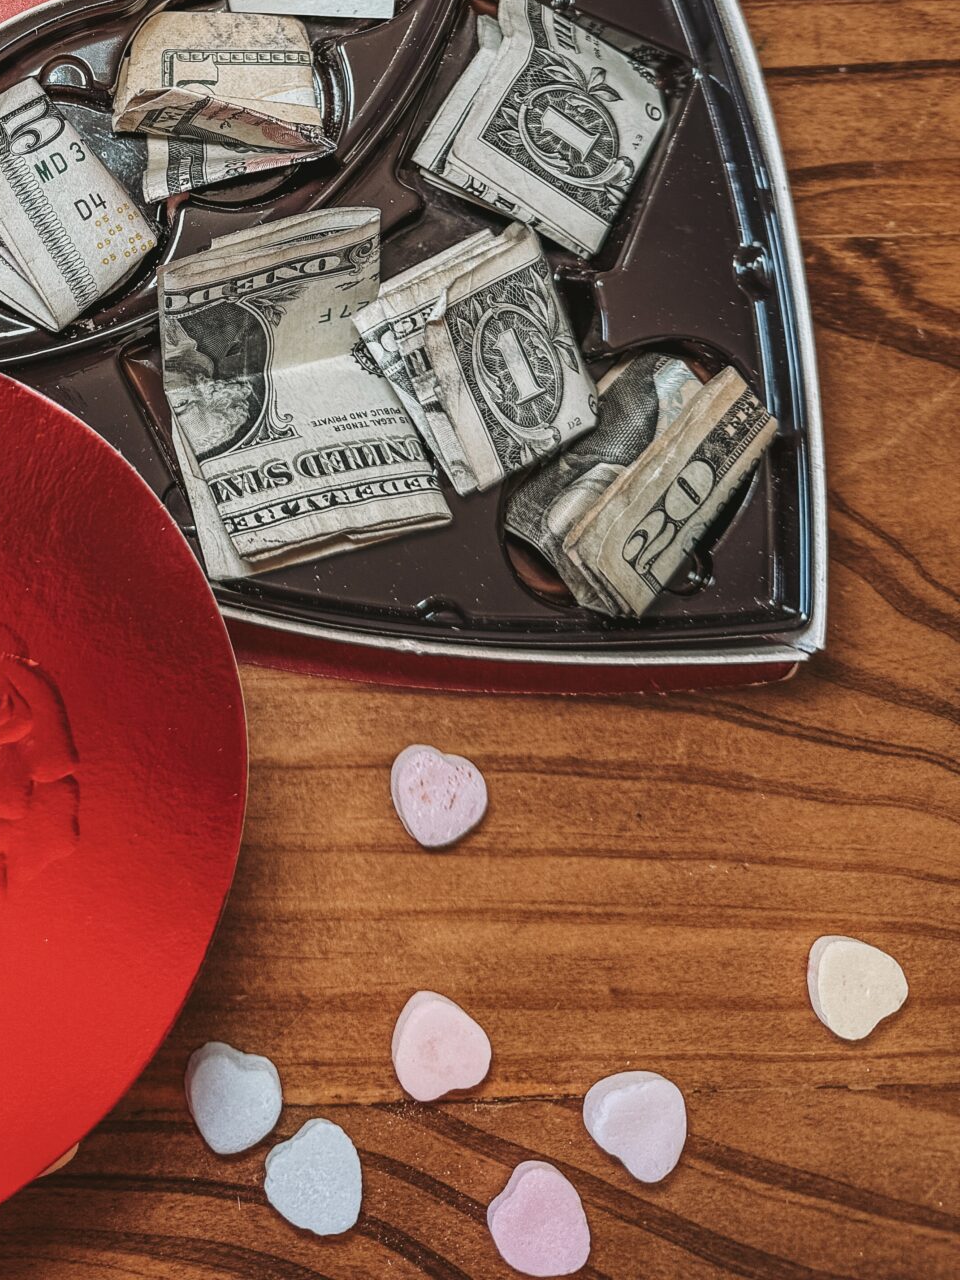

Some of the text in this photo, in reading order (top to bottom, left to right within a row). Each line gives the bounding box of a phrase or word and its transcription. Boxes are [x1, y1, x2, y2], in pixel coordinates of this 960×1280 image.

[73, 192, 107, 222] D4
[493, 328, 547, 405] 1
[349, 411, 369, 420] AND
[292, 433, 426, 478] UNITED
[622, 459, 716, 572] 20
